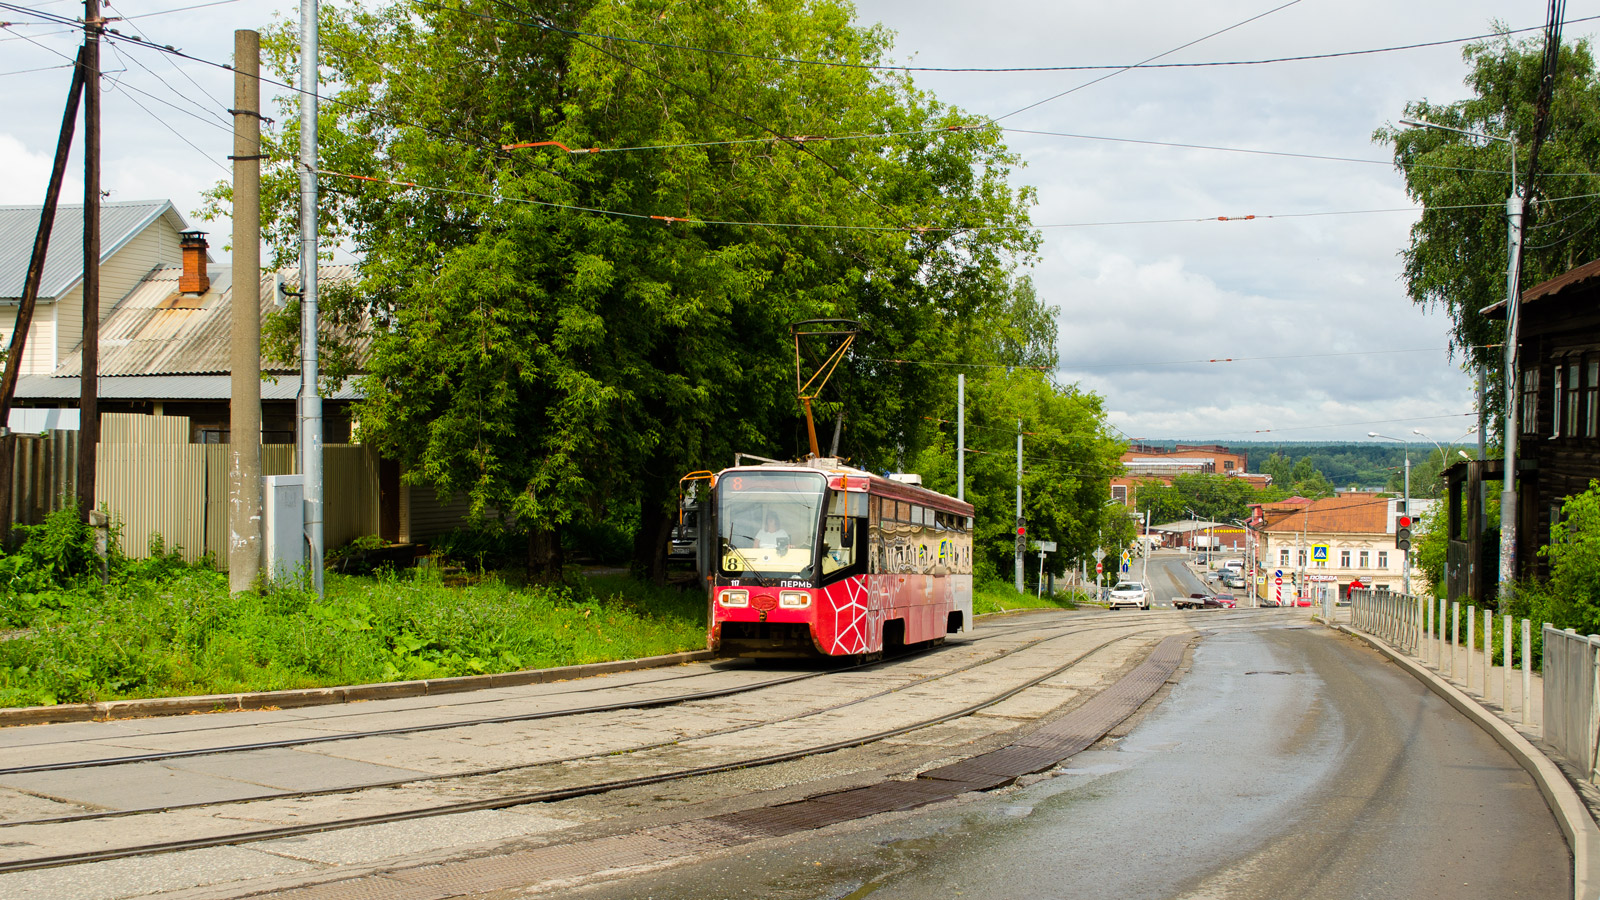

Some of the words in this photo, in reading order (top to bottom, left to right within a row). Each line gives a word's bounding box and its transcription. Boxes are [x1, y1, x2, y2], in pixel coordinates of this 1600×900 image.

[733, 477, 742, 490] 8
[727, 558, 738, 570] 8
[780, 580, 812, 588] ПЕРМЬ
